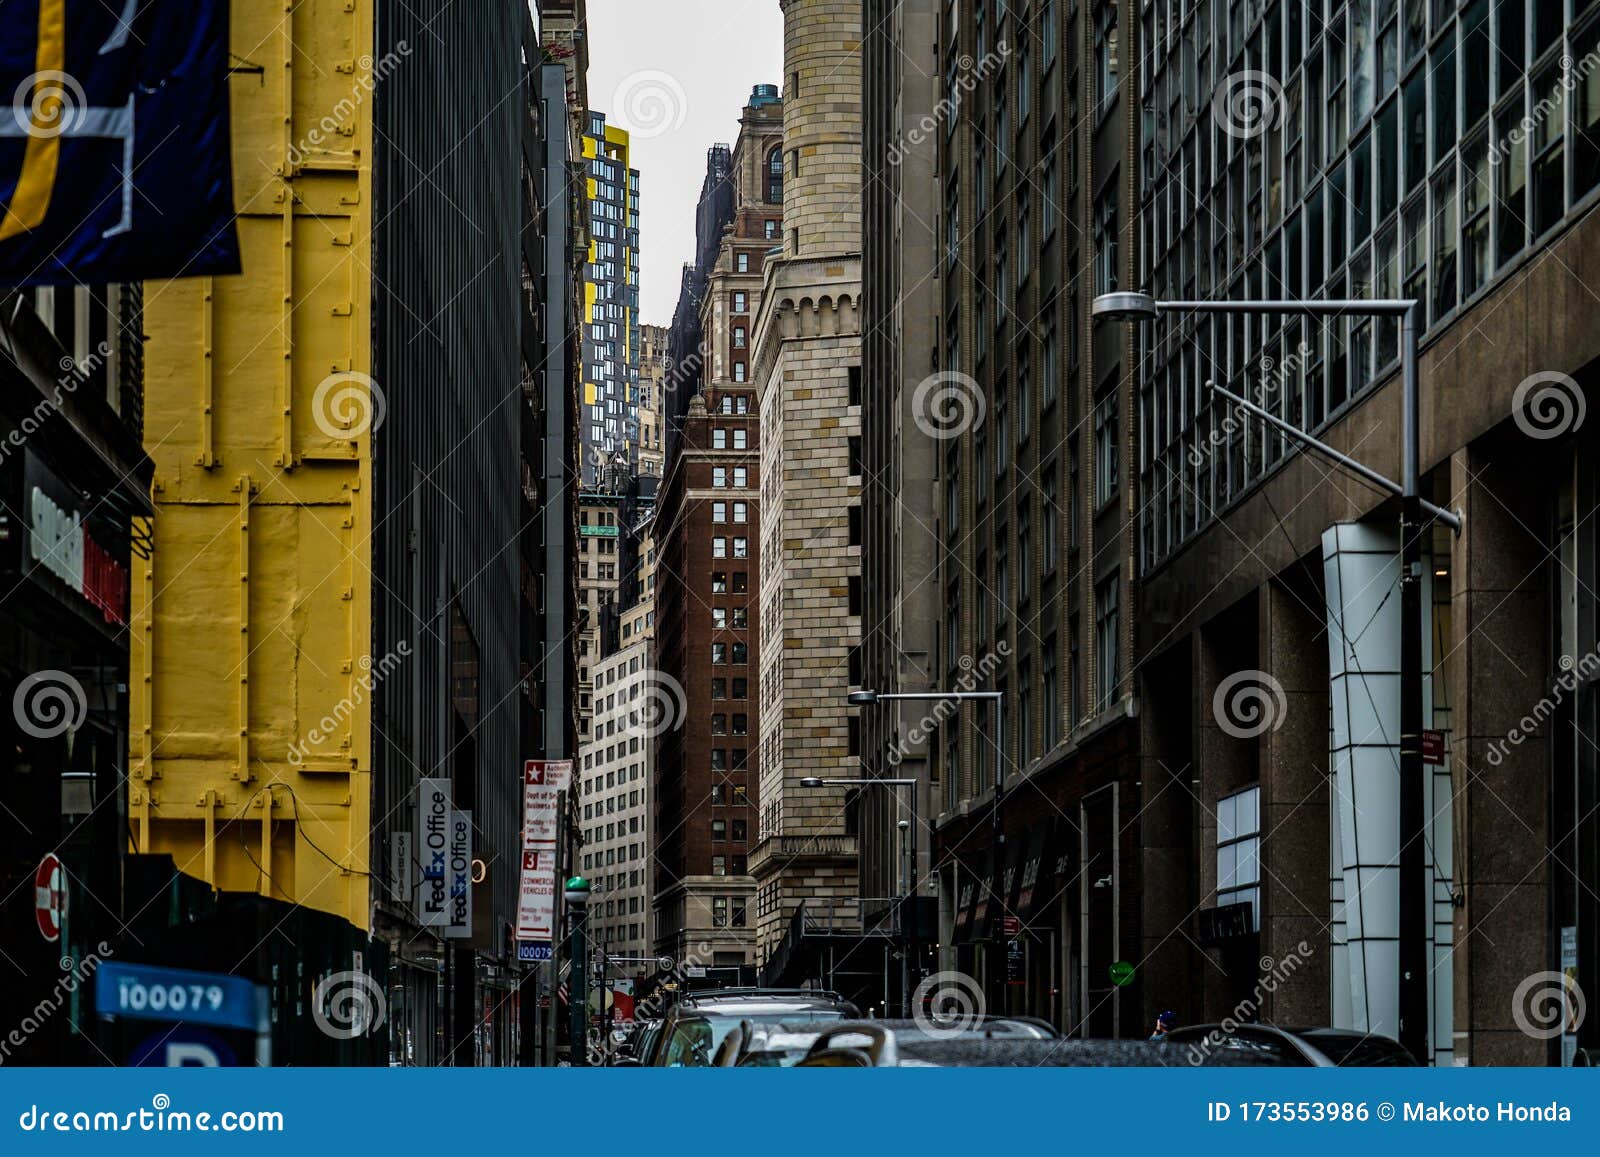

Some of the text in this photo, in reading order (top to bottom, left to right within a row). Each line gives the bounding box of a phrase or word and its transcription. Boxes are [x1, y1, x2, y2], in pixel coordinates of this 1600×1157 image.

[425, 792, 445, 913] FedEx Office
[526, 852, 535, 869] 3
[450, 822, 467, 927] FedEx Office
[523, 876, 554, 886] COMMERCIA
[523, 886, 548, 896] VEHICLES
[520, 946, 552, 958] 100079
[118, 983, 224, 1011] 100079
